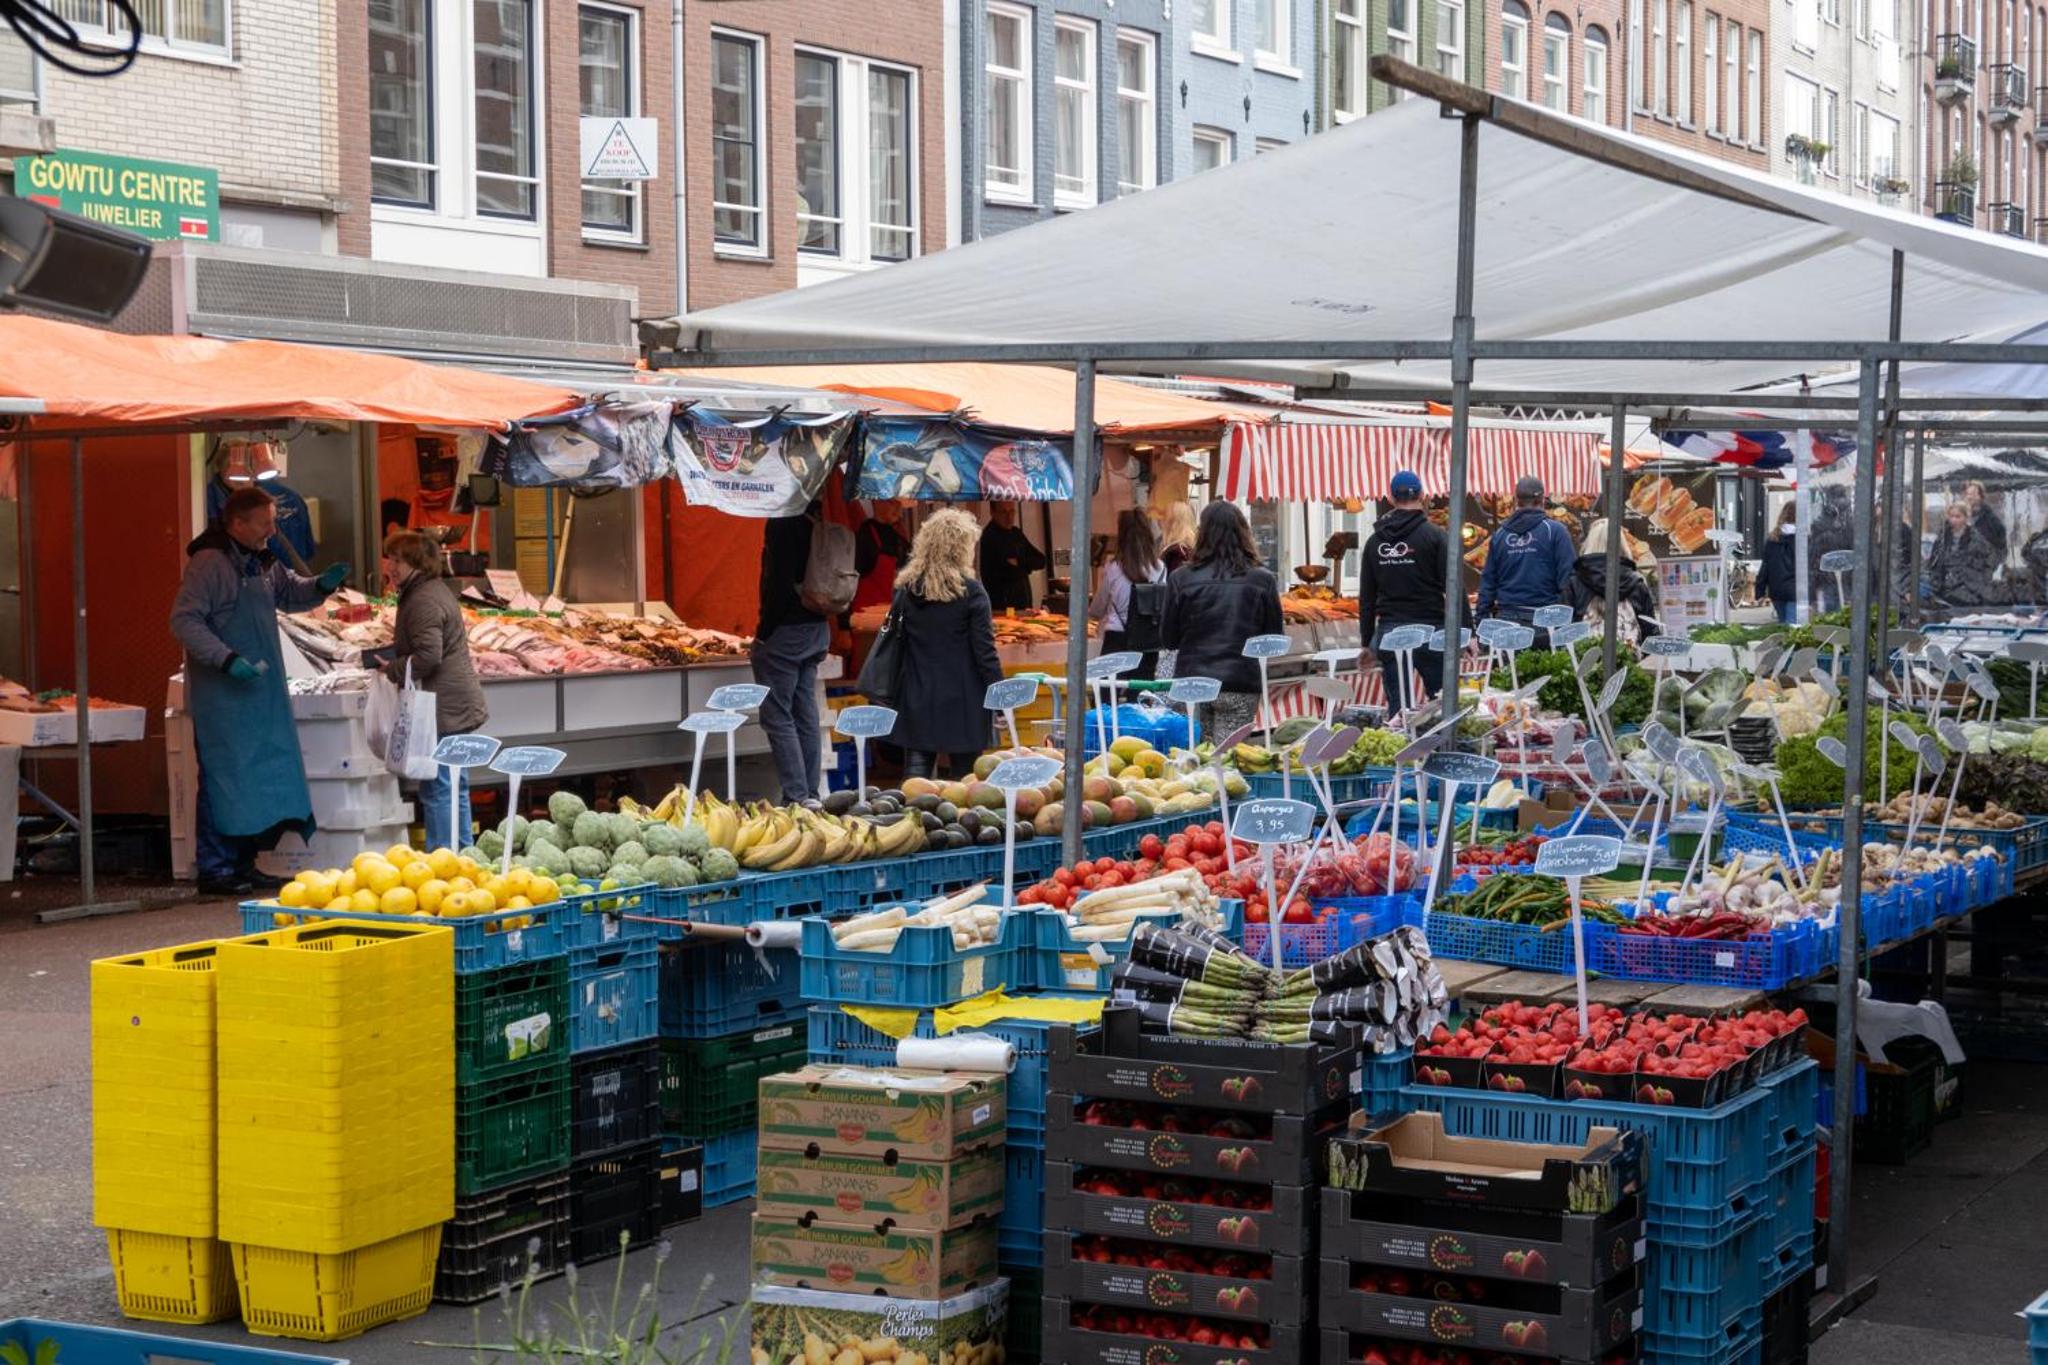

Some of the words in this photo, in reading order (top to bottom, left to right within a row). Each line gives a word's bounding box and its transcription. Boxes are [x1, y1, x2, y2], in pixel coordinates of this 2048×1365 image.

[30, 157, 114, 197] GOWTU
[119, 169, 207, 208] CENTRE
[880, 1320, 935, 1341] Champs
